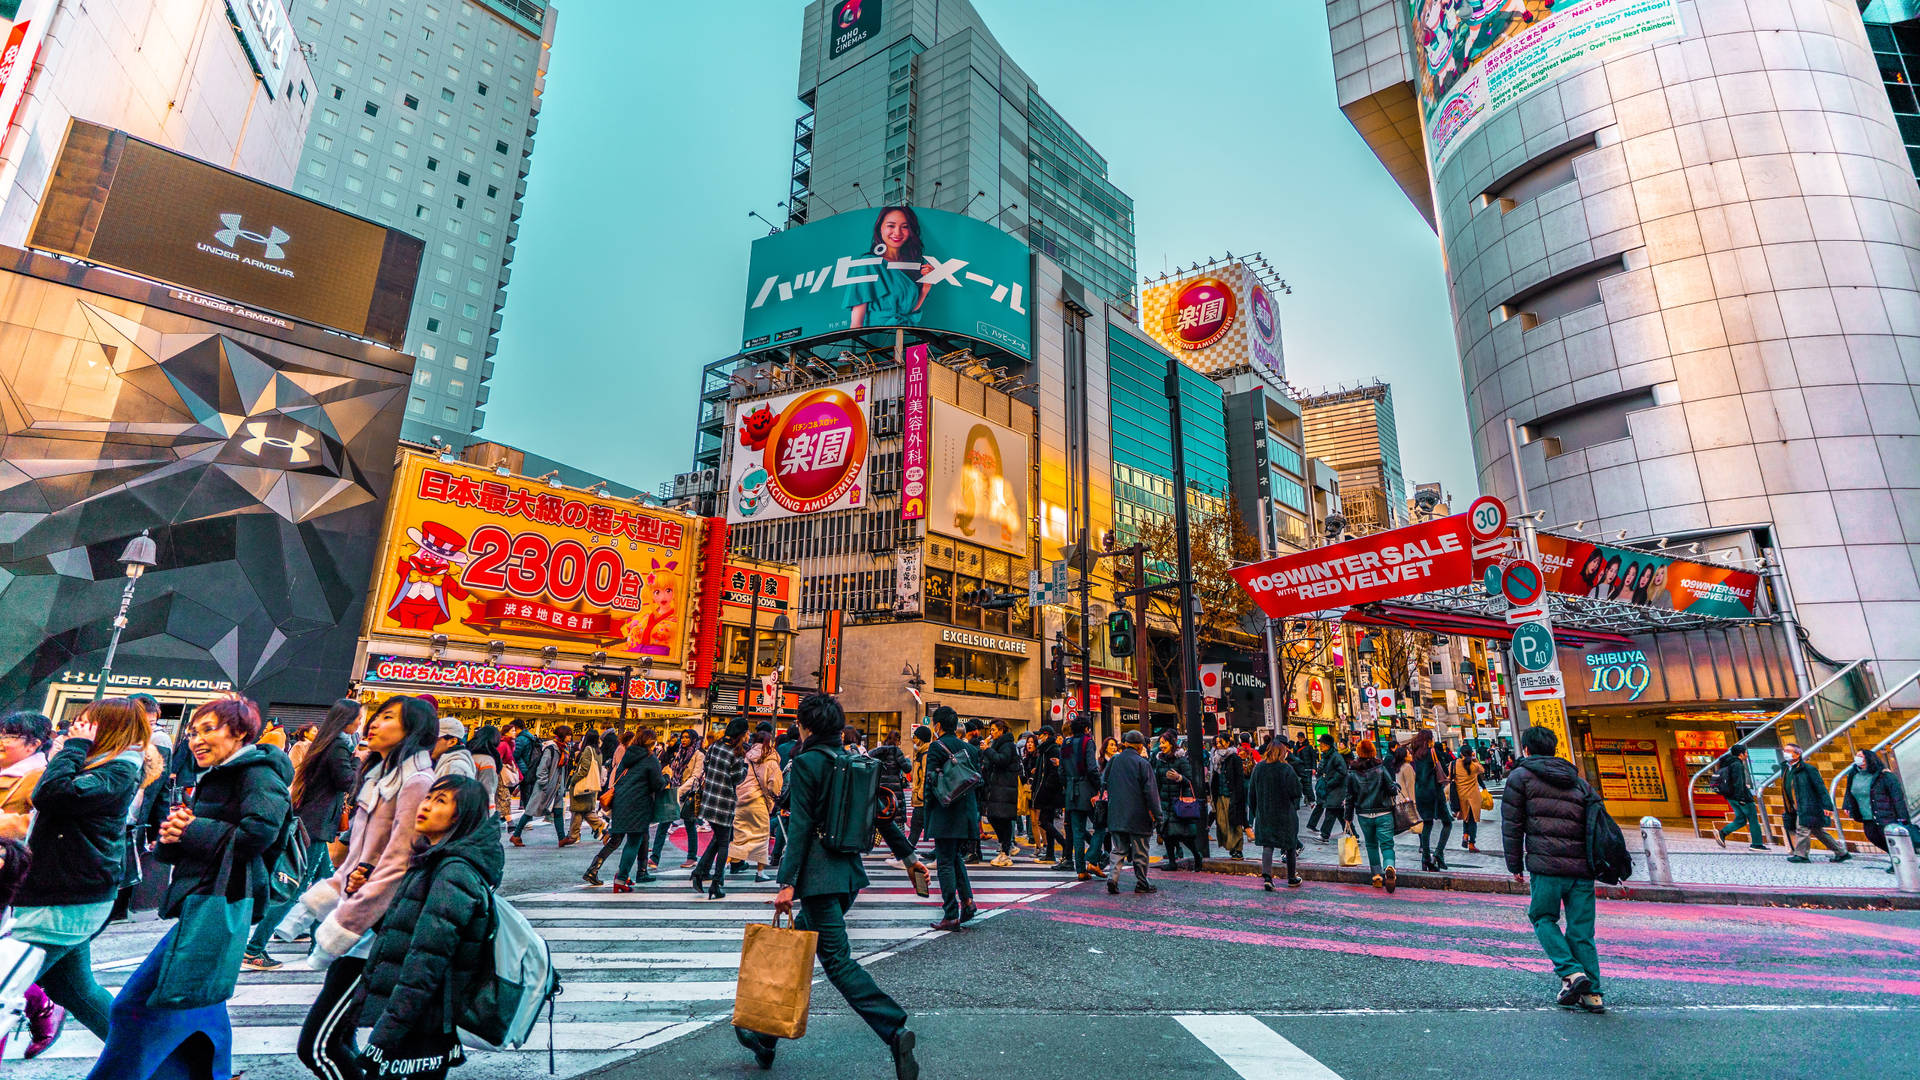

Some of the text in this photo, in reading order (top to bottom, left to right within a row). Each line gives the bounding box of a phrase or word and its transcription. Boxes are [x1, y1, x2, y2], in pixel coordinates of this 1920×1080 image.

[836, 27, 859, 46] TOHO
[1568, 25, 1592, 40] Hop?
[1594, 14, 1621, 29] Stop?
[835, 30, 867, 54] CINEMAS
[1513, 35, 1543, 56] Release!
[1530, 61, 1560, 79] Brightest
[1560, 49, 1584, 64] Melody
[1589, 40, 1607, 51] Over
[1608, 34, 1622, 44] The
[1622, 29, 1640, 39] Next
[197, 242, 295, 278] UNDER ARMOUR
[193, 297, 286, 328] UNDER ARMOUR
[1176, 297, 1225, 332] 楽園
[1196, 316, 1234, 350] AMUSEMENT
[907, 366, 924, 466] 品川美容外科
[778, 426, 852, 477] 楽園
[766, 460, 861, 512] EXCITING AMUSEMENT
[417, 468, 684, 551] 日本最大級の超大型店
[1475, 506, 1498, 531] 30
[591, 535, 674, 557] メガホール
[732, 571, 778, 596] 吉家
[1276, 587, 1298, 597] WITH
[613, 596, 639, 609] OVER
[730, 592, 777, 608] YOSHOYA
[503, 603, 594, 630] 渋谷地区合計
[943, 629, 1027, 654] EXCELSIOR CAFFÉ
[1520, 636, 1537, 667] P
[1534, 650, 1547, 665] 40
[1586, 650, 1647, 666] SHIBUYA
[88, 672, 232, 690] UNDER ARMOUR
[1235, 673, 1266, 688] CINEMA
[1588, 663, 1650, 702] 109
[391, 1055, 443, 1075] CONTENT
